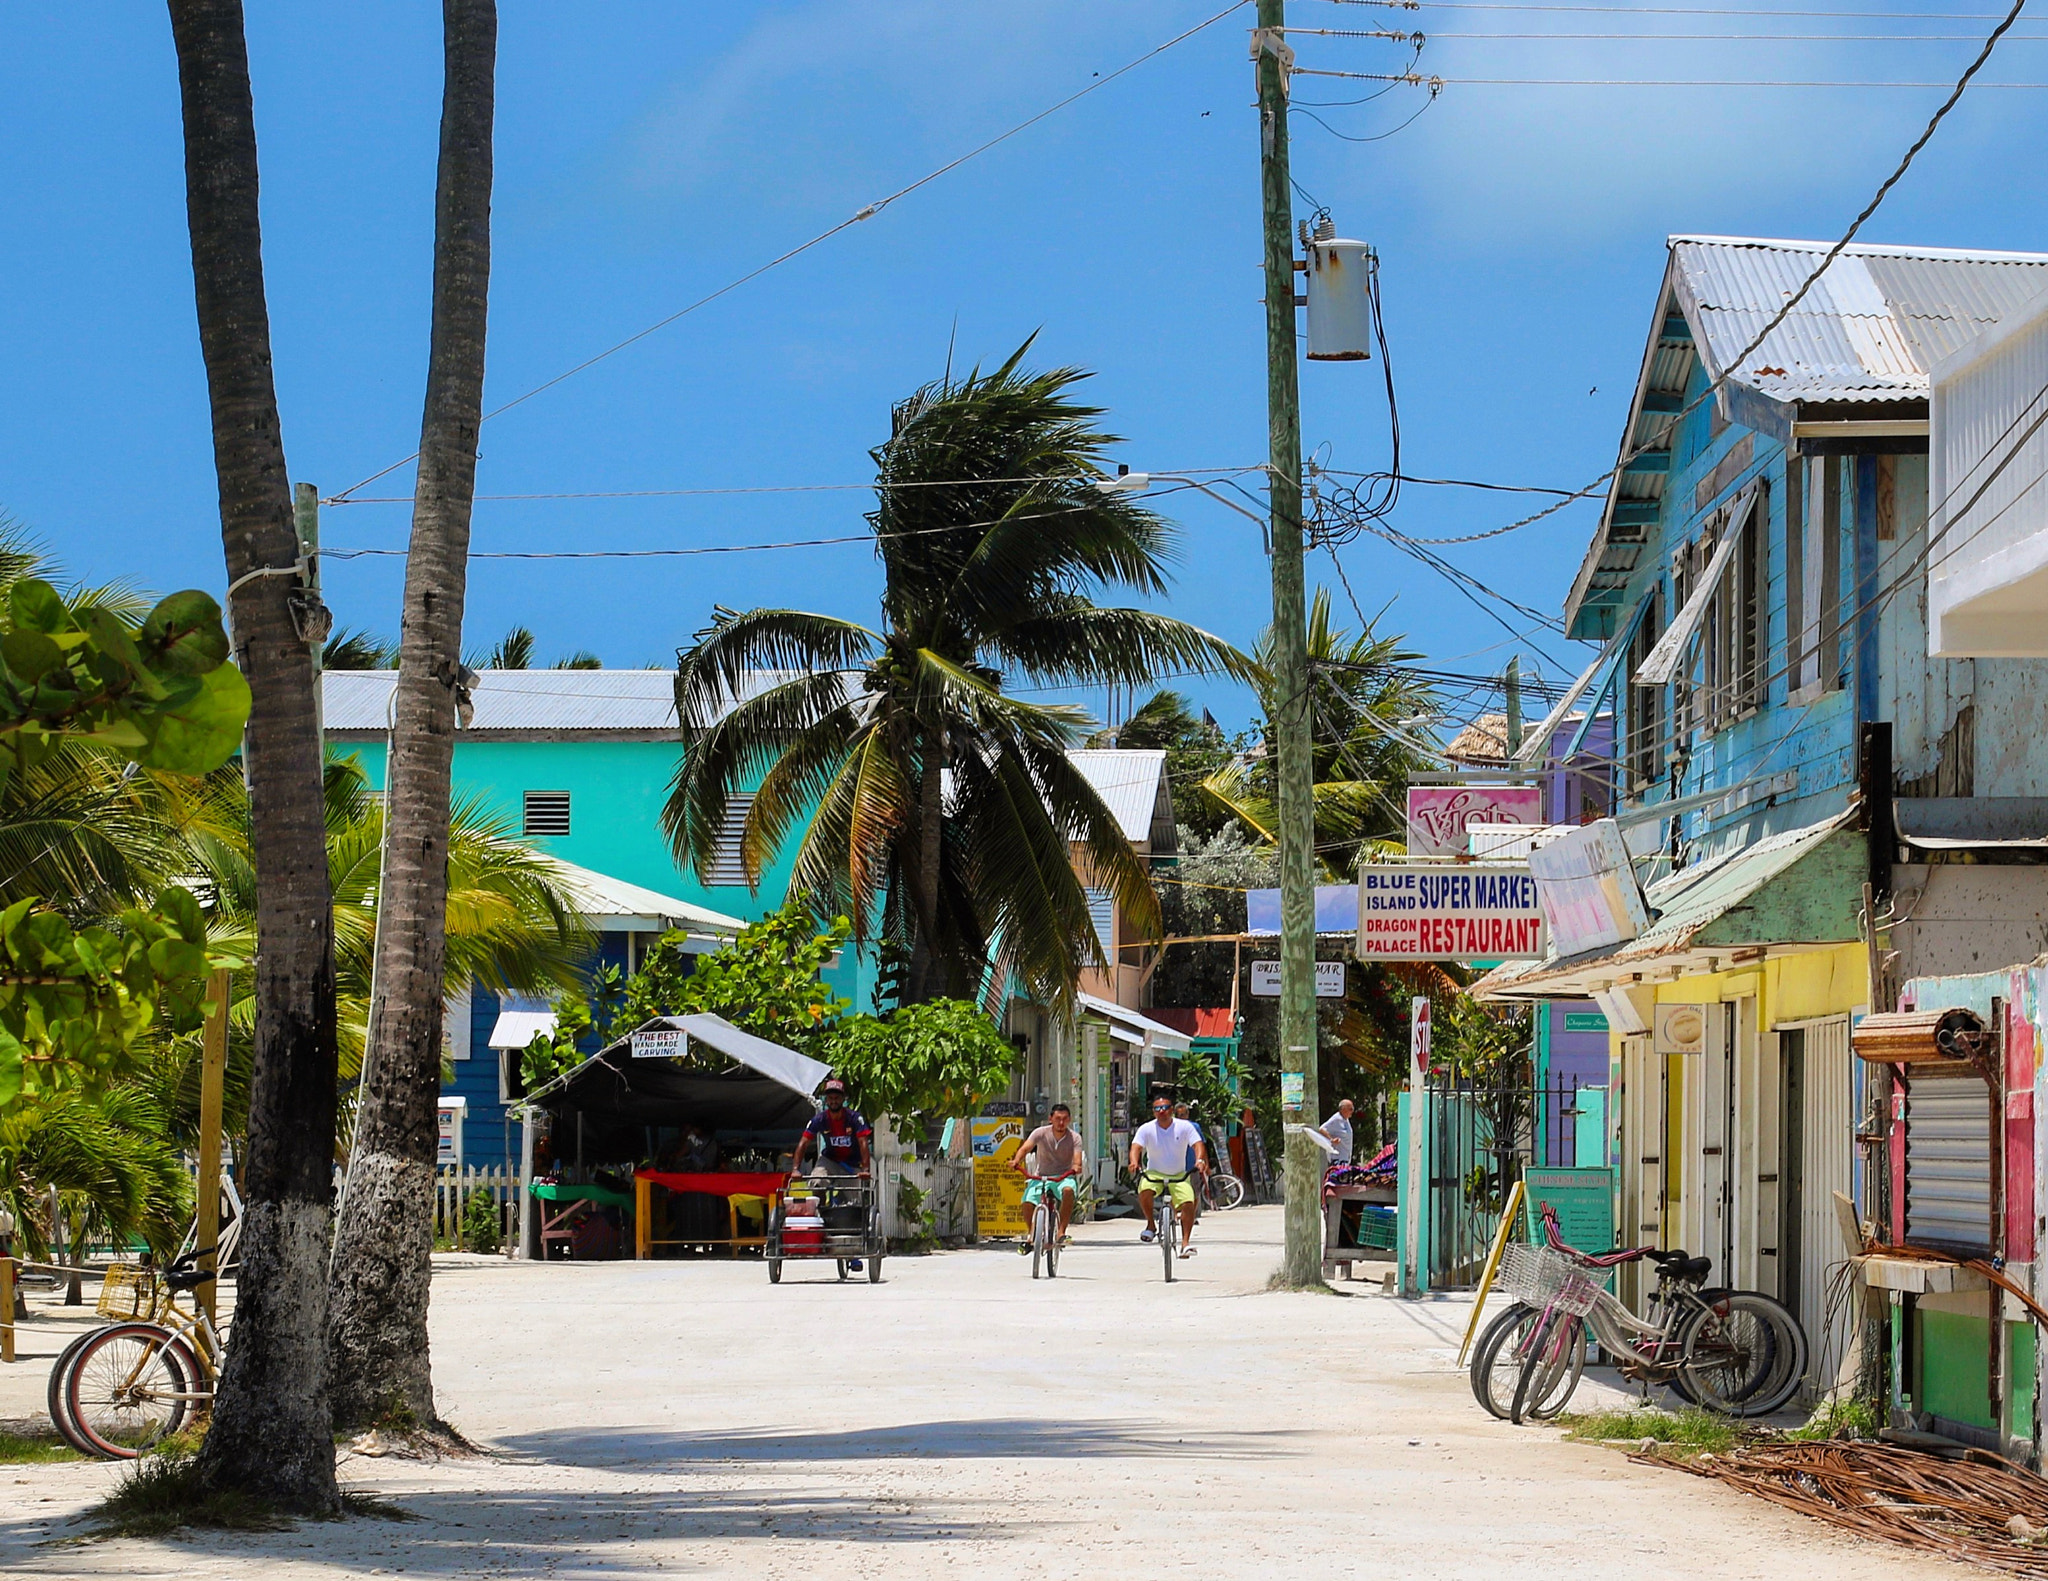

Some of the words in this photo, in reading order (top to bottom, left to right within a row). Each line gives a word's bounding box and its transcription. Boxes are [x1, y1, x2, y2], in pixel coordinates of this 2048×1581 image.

[1367, 875, 1415, 889] BLUE
[1420, 875, 1471, 909] SUPER
[1475, 875, 1538, 909] MARKET
[1367, 896, 1416, 910] ISLAND
[1367, 919, 1417, 932] DRAGON
[1420, 918, 1541, 953] RESTAURANT
[1367, 939, 1416, 953] PALACE
[638, 1033, 656, 1041] THE
[657, 1032, 679, 1041] BEST
[656, 1040, 679, 1048] MADE
[639, 1048, 676, 1056] CARVING
[994, 1122, 1022, 1144] BEANS
